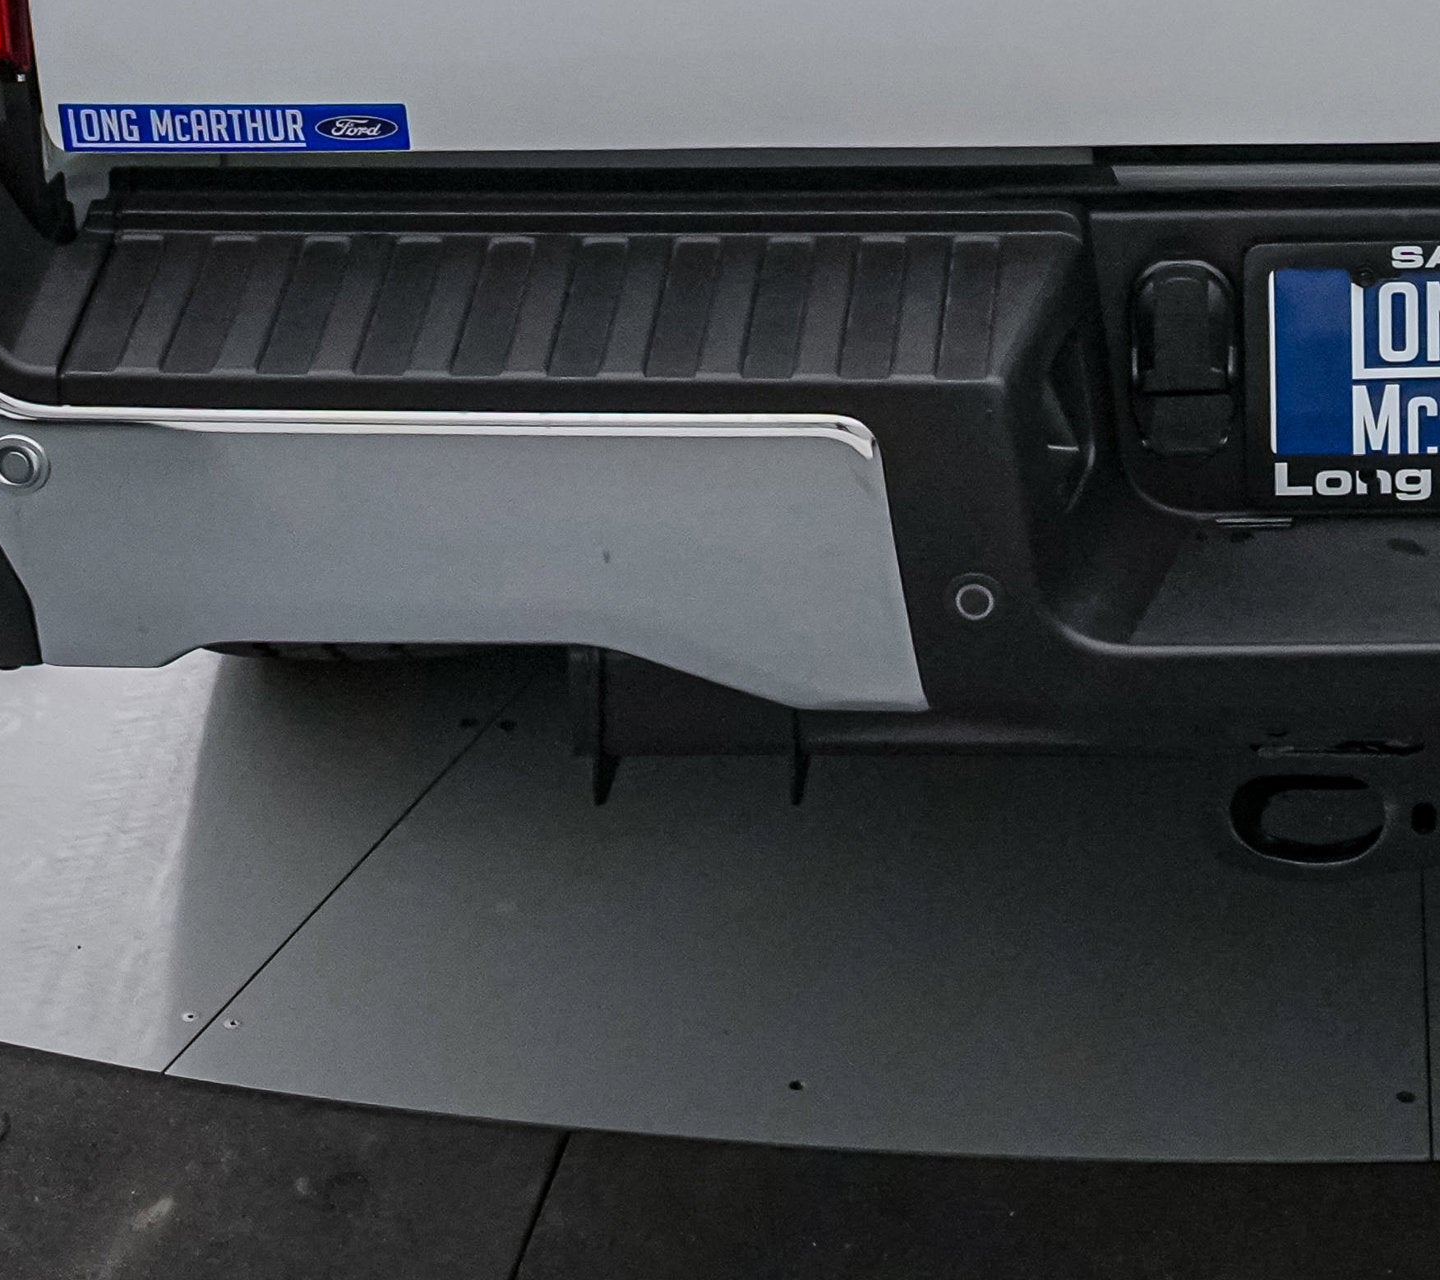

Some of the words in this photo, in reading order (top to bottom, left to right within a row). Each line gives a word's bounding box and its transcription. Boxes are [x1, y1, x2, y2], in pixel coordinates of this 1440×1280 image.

[67, 109, 139, 148] LONG
[150, 109, 306, 143] McARTHUR
[330, 119, 383, 137] Ford
[1274, 462, 1432, 501] Long
